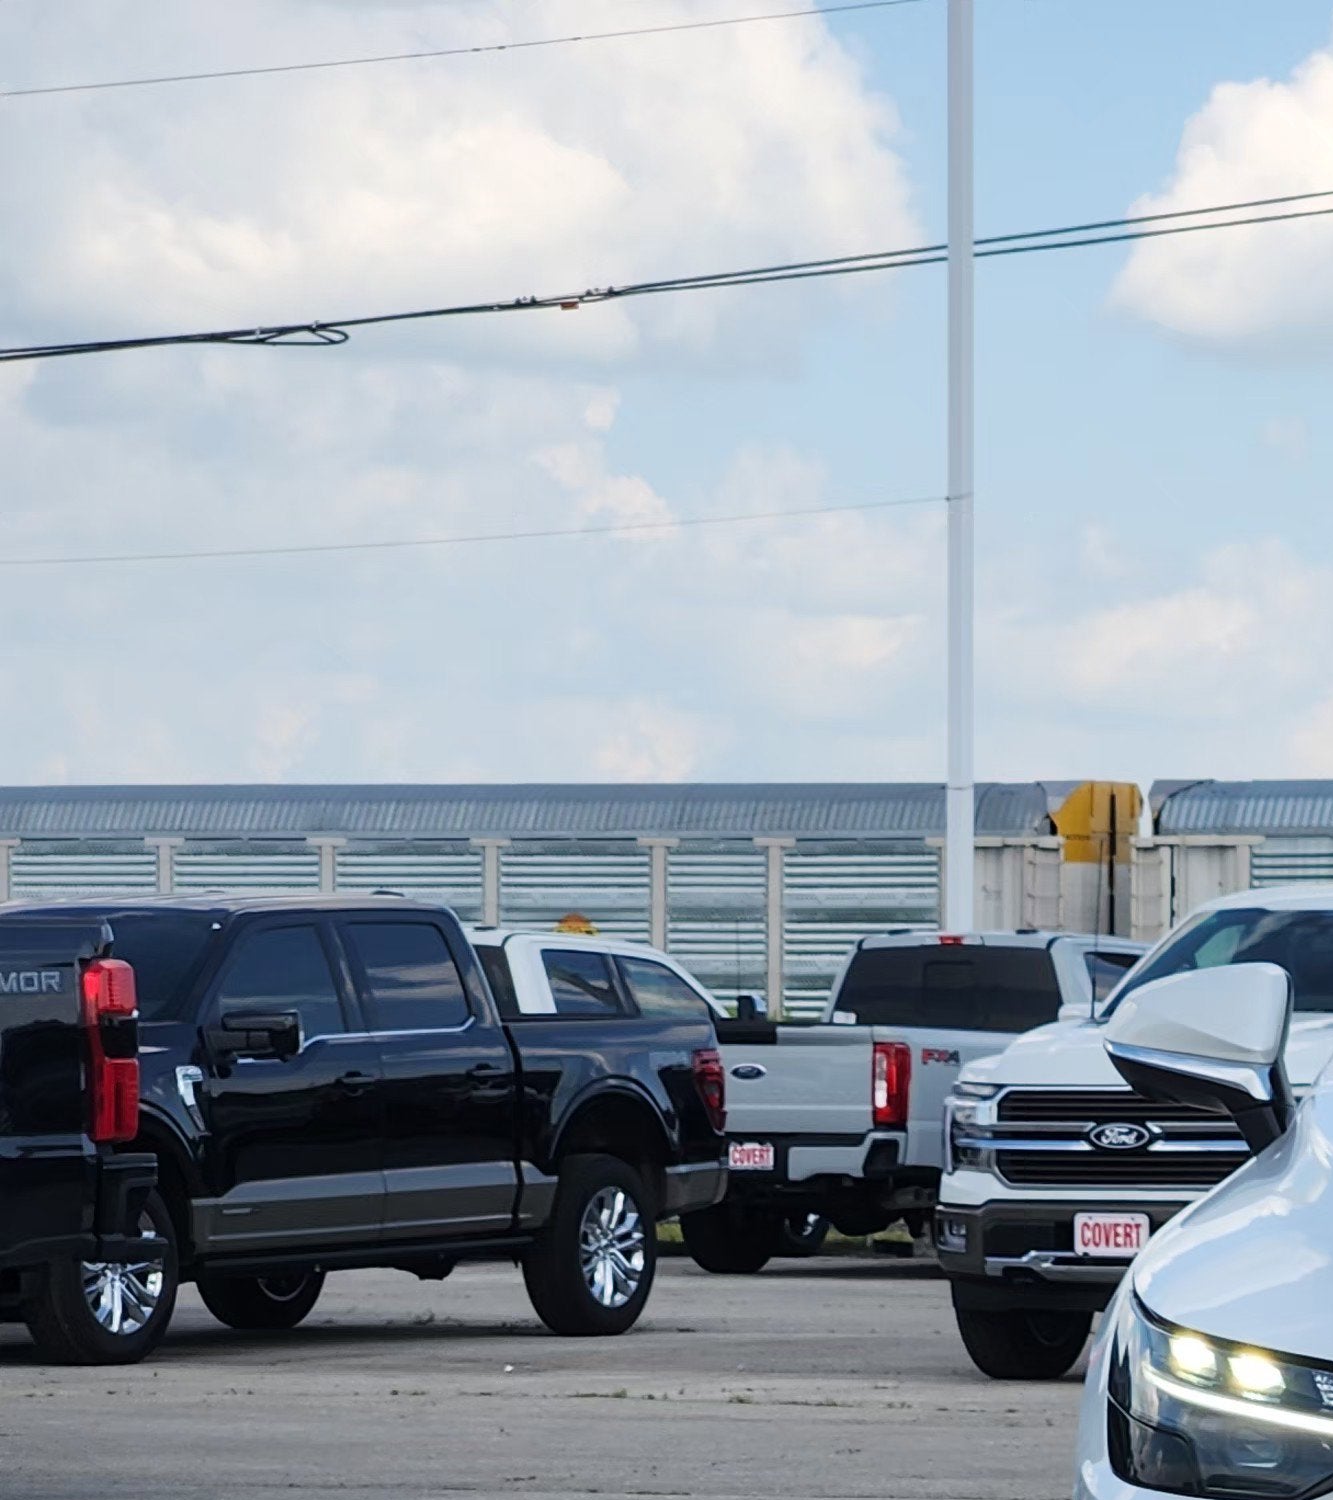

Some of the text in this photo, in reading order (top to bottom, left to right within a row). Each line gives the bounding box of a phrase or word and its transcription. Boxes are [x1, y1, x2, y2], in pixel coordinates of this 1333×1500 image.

[1100, 1127, 1138, 1145] Ford
[731, 1146, 771, 1165] COVERT
[1080, 1221, 1142, 1249] COVERT
